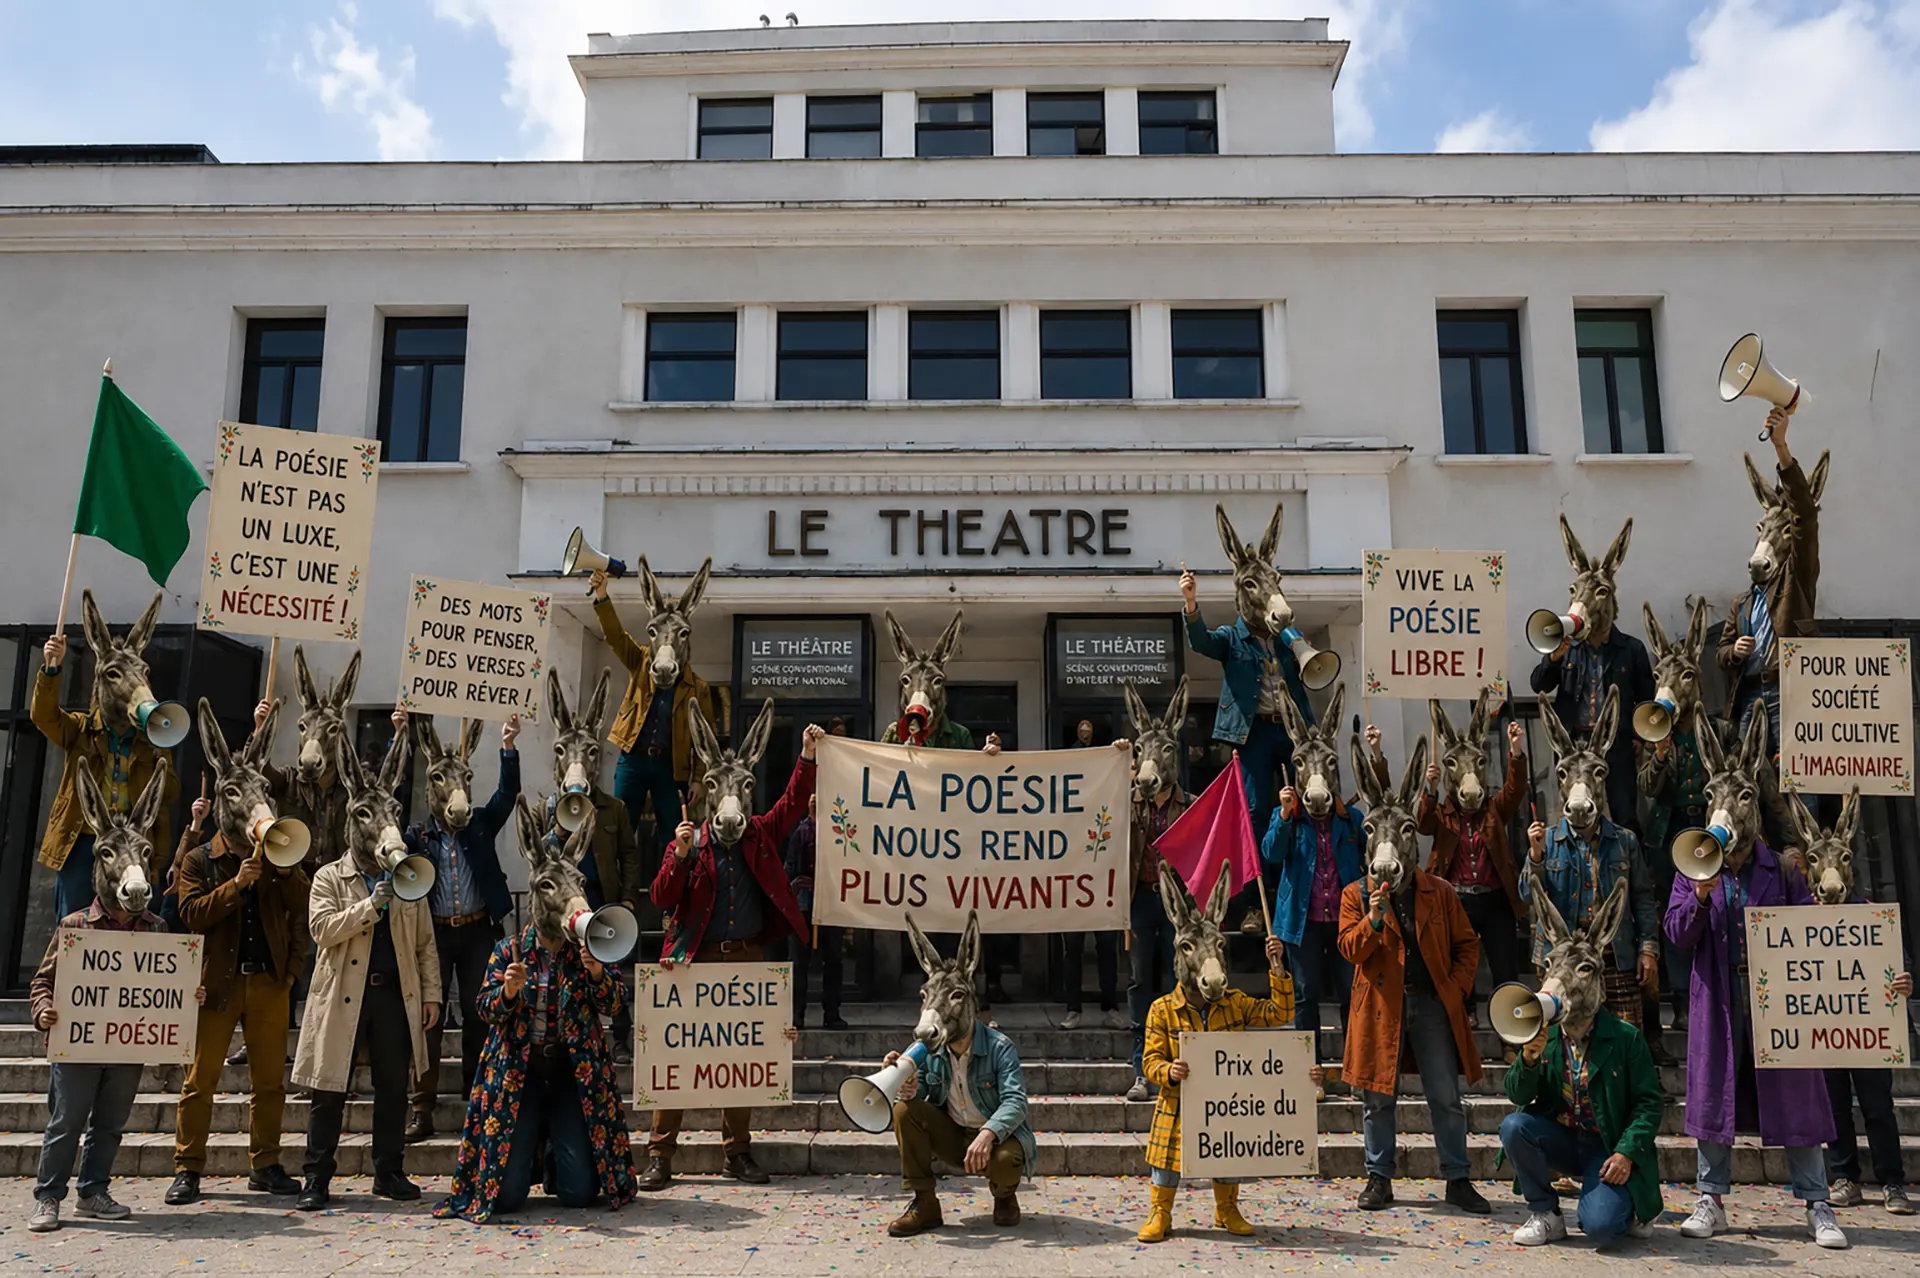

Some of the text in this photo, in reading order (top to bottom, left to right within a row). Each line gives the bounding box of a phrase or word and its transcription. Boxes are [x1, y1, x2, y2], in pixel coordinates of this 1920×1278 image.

[238, 445, 348, 479] LA POÉSIE
[241, 481, 346, 514] N'EST PAS
[242, 517, 340, 551] UN LUXE,
[767, 509, 1132, 556] LE THEATRE
[230, 551, 339, 585] C'EST UNE
[1396, 570, 1474, 591] VIVE LA
[440, 596, 522, 623] DES MOTS
[1390, 599, 1481, 634] POÉSIE
[421, 620, 538, 654] POUR PENSER,
[751, 637, 853, 655] LE THÉÂTRE
[1066, 640, 1086, 654] LE
[425, 649, 525, 678] DES VERSES
[1801, 656, 1891, 676] POUR UNE
[412, 677, 458, 699] POUR
[1812, 684, 1880, 709] SOCIÉTÉ
[1795, 722, 1900, 744] QUI CULTIVE
[1791, 753, 1904, 777] L'IMAGINAIRE
[861, 765, 1084, 815] LA POÉSIE
[872, 824, 1069, 861] NOUS REND
[840, 869, 928, 908] PLUS
[1766, 919, 1883, 948] LA POÉSIE
[82, 949, 177, 974] NOS VIES
[1786, 959, 1865, 981] EST LA
[71, 985, 183, 1010] ONT BESOIN
[653, 975, 778, 1008] LA POÉSIE
[1785, 987, 1871, 1015] BEAUTÉ
[69, 1016, 180, 1045] DE POÉSIE
[664, 1021, 764, 1048] CHANGE
[1771, 1027, 1891, 1050] DU MONDE
[652, 1061, 778, 1091] LE MONDE
[1215, 1049, 1284, 1076] Prix de
[1205, 1089, 1296, 1127] poésie du
[1198, 1130, 1304, 1159] Bellovidère
